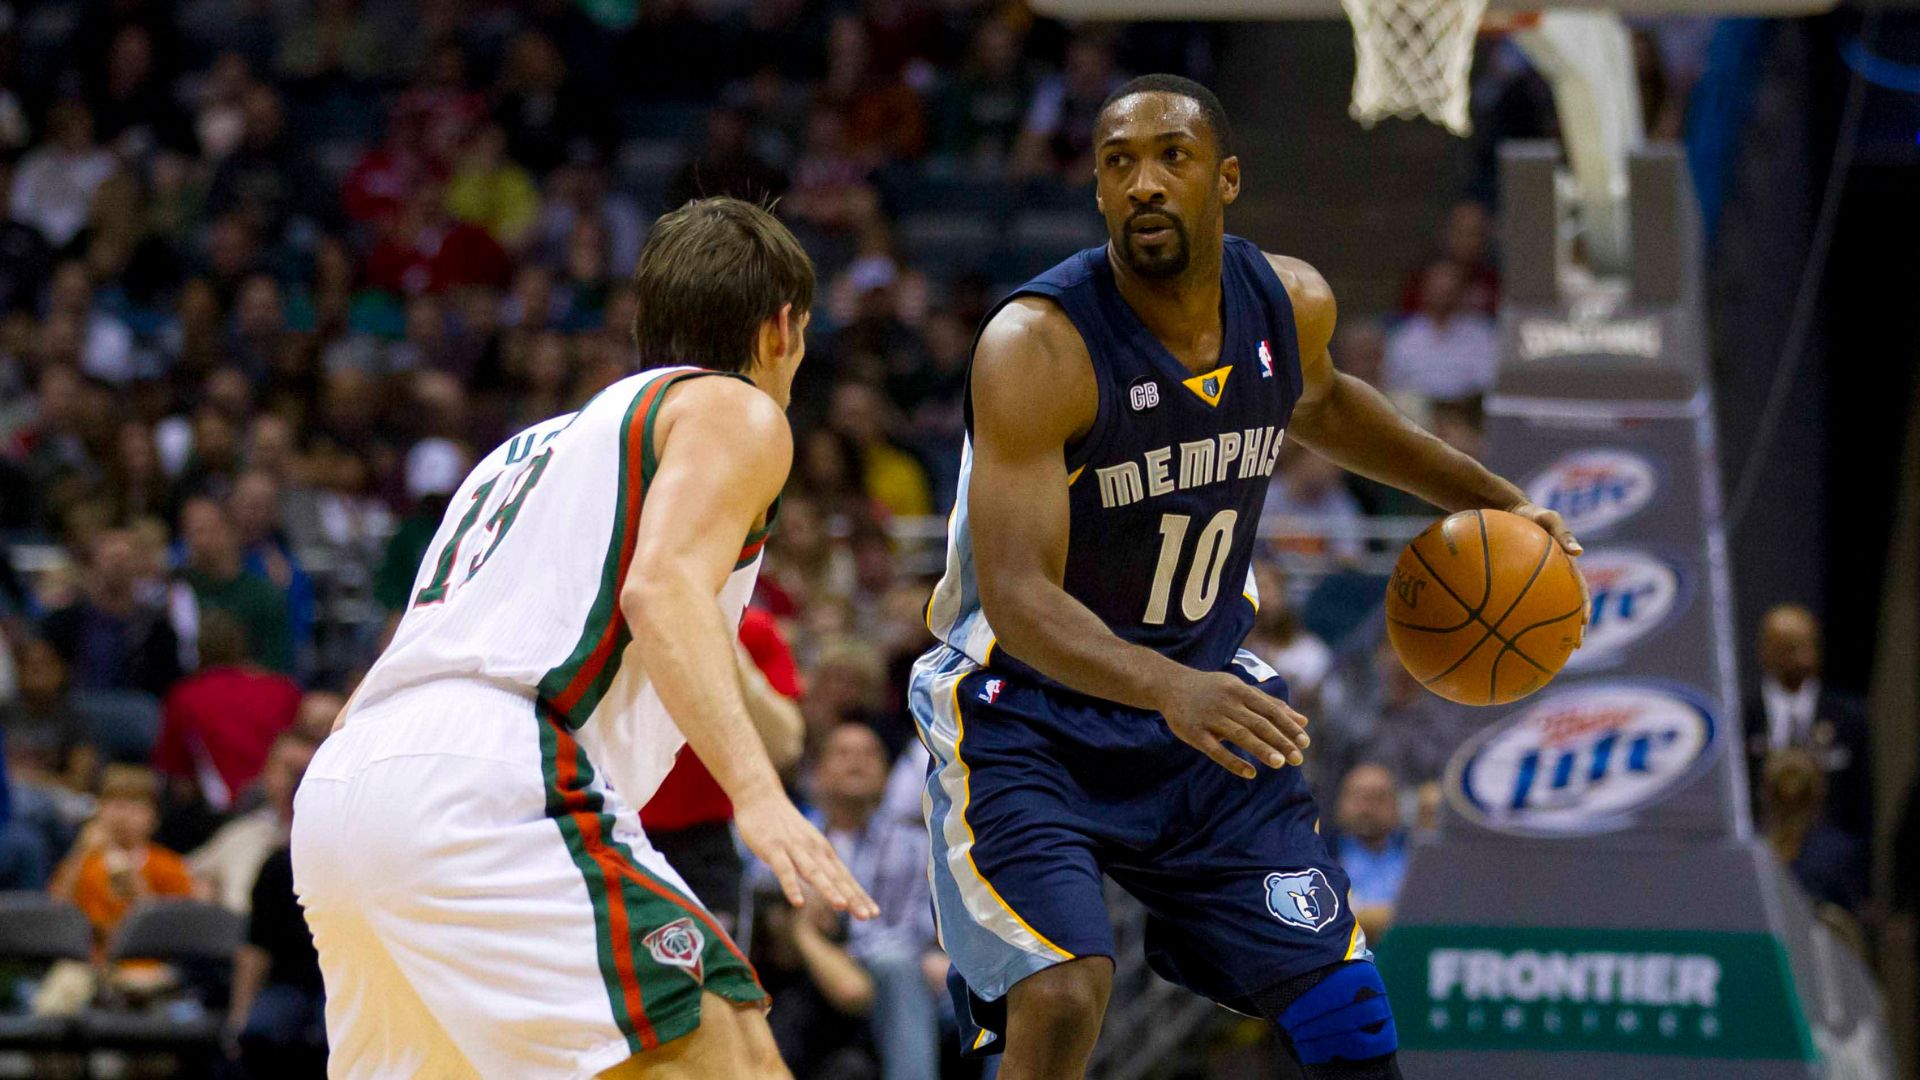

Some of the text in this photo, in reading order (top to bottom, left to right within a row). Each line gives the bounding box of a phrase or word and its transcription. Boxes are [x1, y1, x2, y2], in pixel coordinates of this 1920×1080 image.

[1130, 382, 1159, 411] GB
[1095, 426, 1285, 508] MEMPHIS
[1142, 509, 1237, 624] 10
[1427, 948, 1721, 1007] FRONTIER
